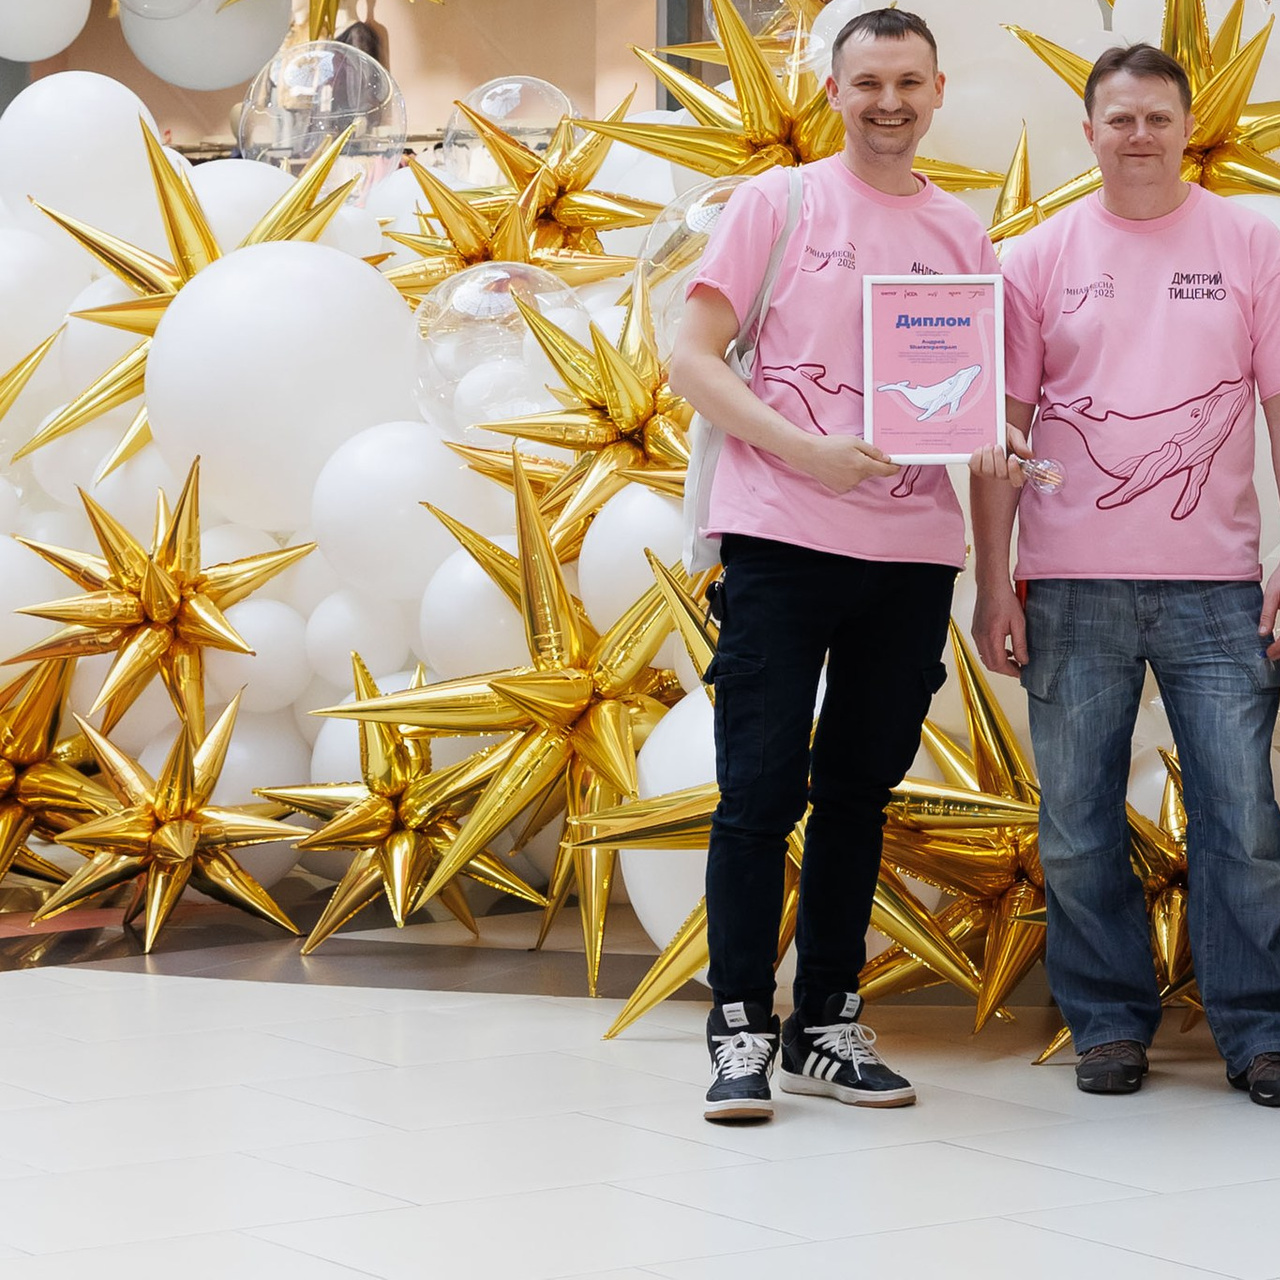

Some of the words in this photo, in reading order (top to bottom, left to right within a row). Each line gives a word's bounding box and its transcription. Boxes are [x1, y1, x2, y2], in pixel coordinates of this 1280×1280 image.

[837, 257, 856, 270] 2025
[1171, 271, 1223, 285] ДМИТРИЙ
[1094, 289, 1115, 299] 2025
[1168, 287, 1227, 301] ТИЩЕНКО
[895, 314, 971, 329] Диплом
